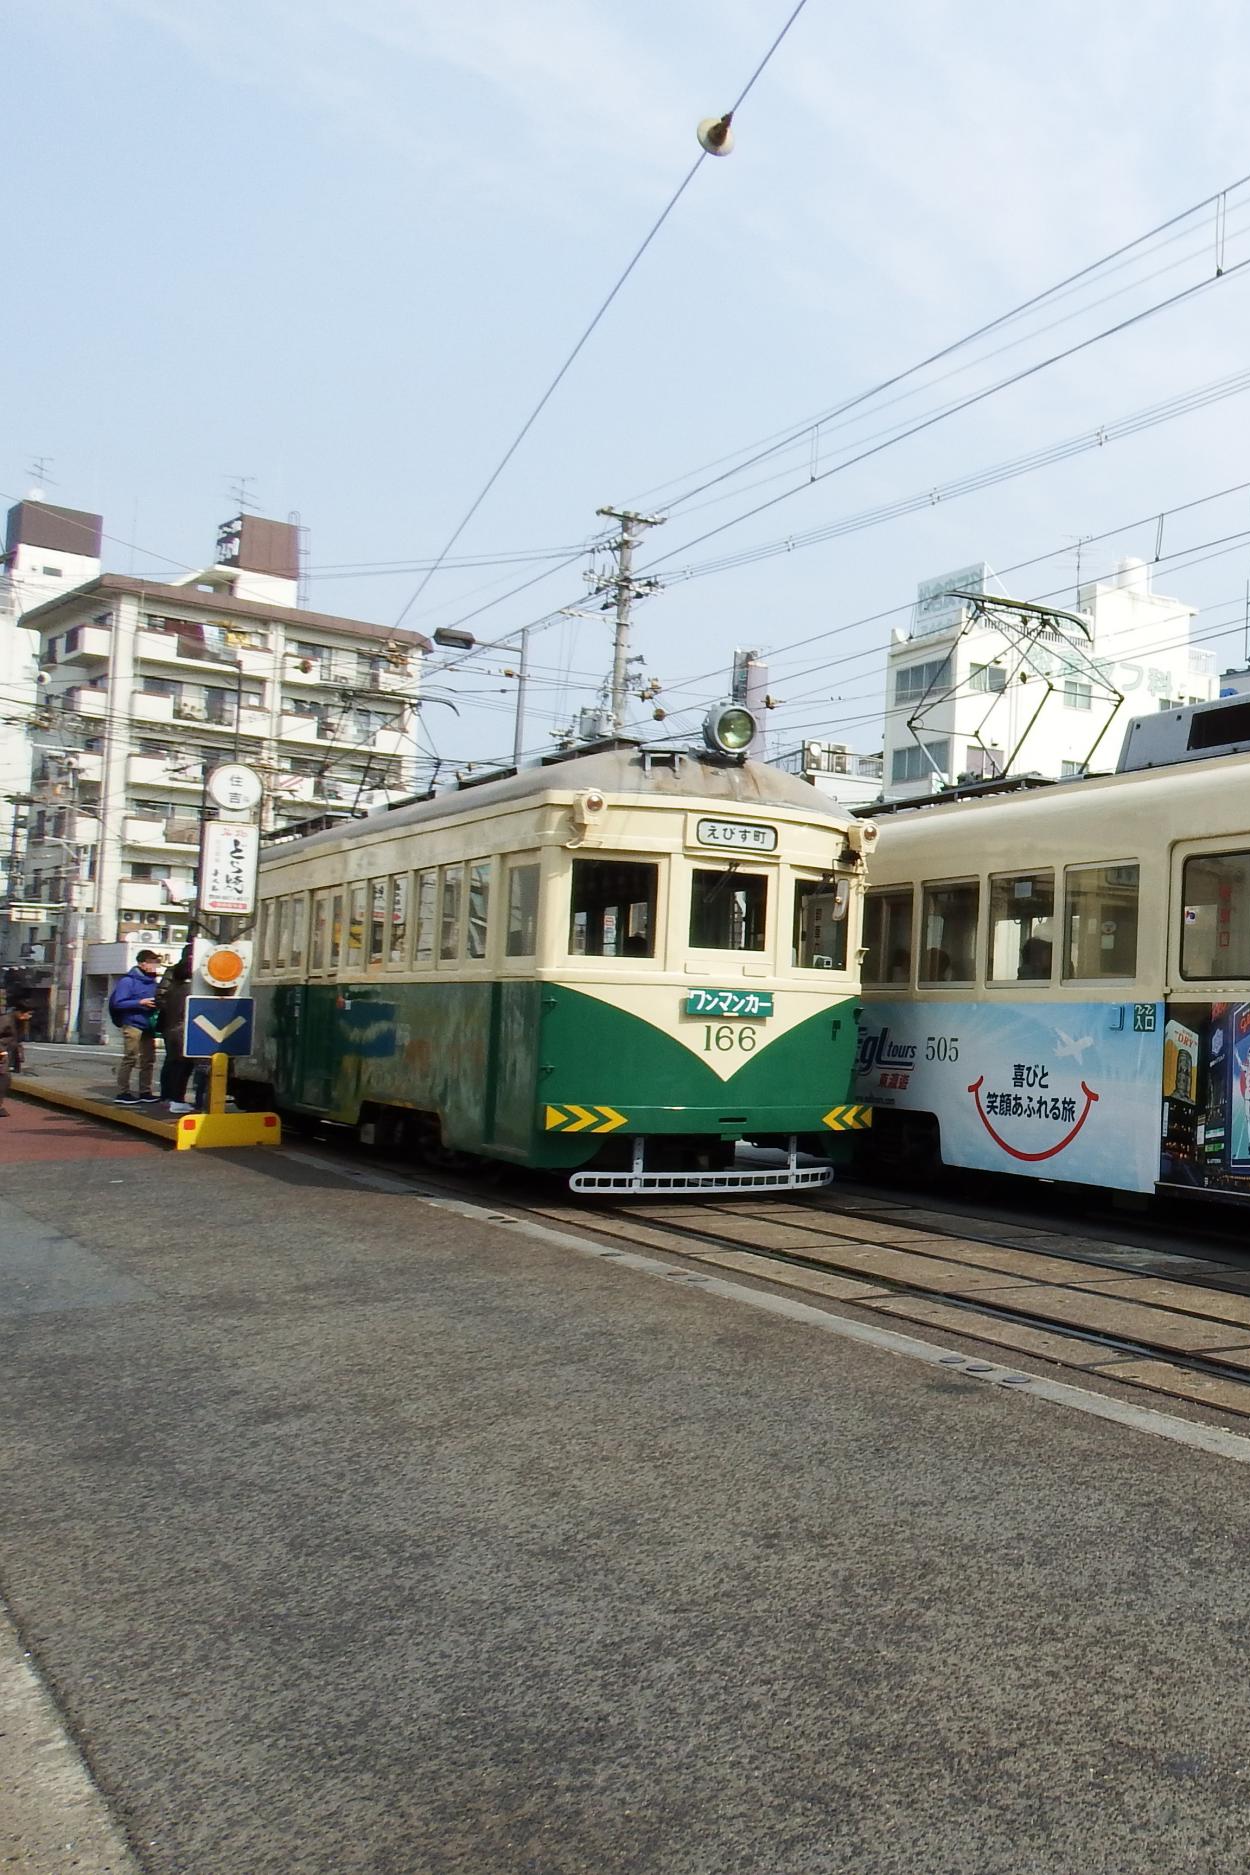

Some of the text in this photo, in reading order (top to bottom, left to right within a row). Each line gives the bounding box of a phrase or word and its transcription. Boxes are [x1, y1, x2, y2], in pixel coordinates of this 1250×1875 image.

[228, 774, 244, 804] 住吉
[706, 825, 767, 845] えびす町
[689, 990, 772, 1014] ワンマンカー
[1134, 1016, 1154, 1031] 入口
[704, 1025, 756, 1051] 166
[887, 1040, 917, 1058] tours
[925, 1036, 959, 1062] 505
[1012, 1063, 1049, 1089] 喜びと
[986, 1091, 1076, 1122] 笑顔あふれる旅
